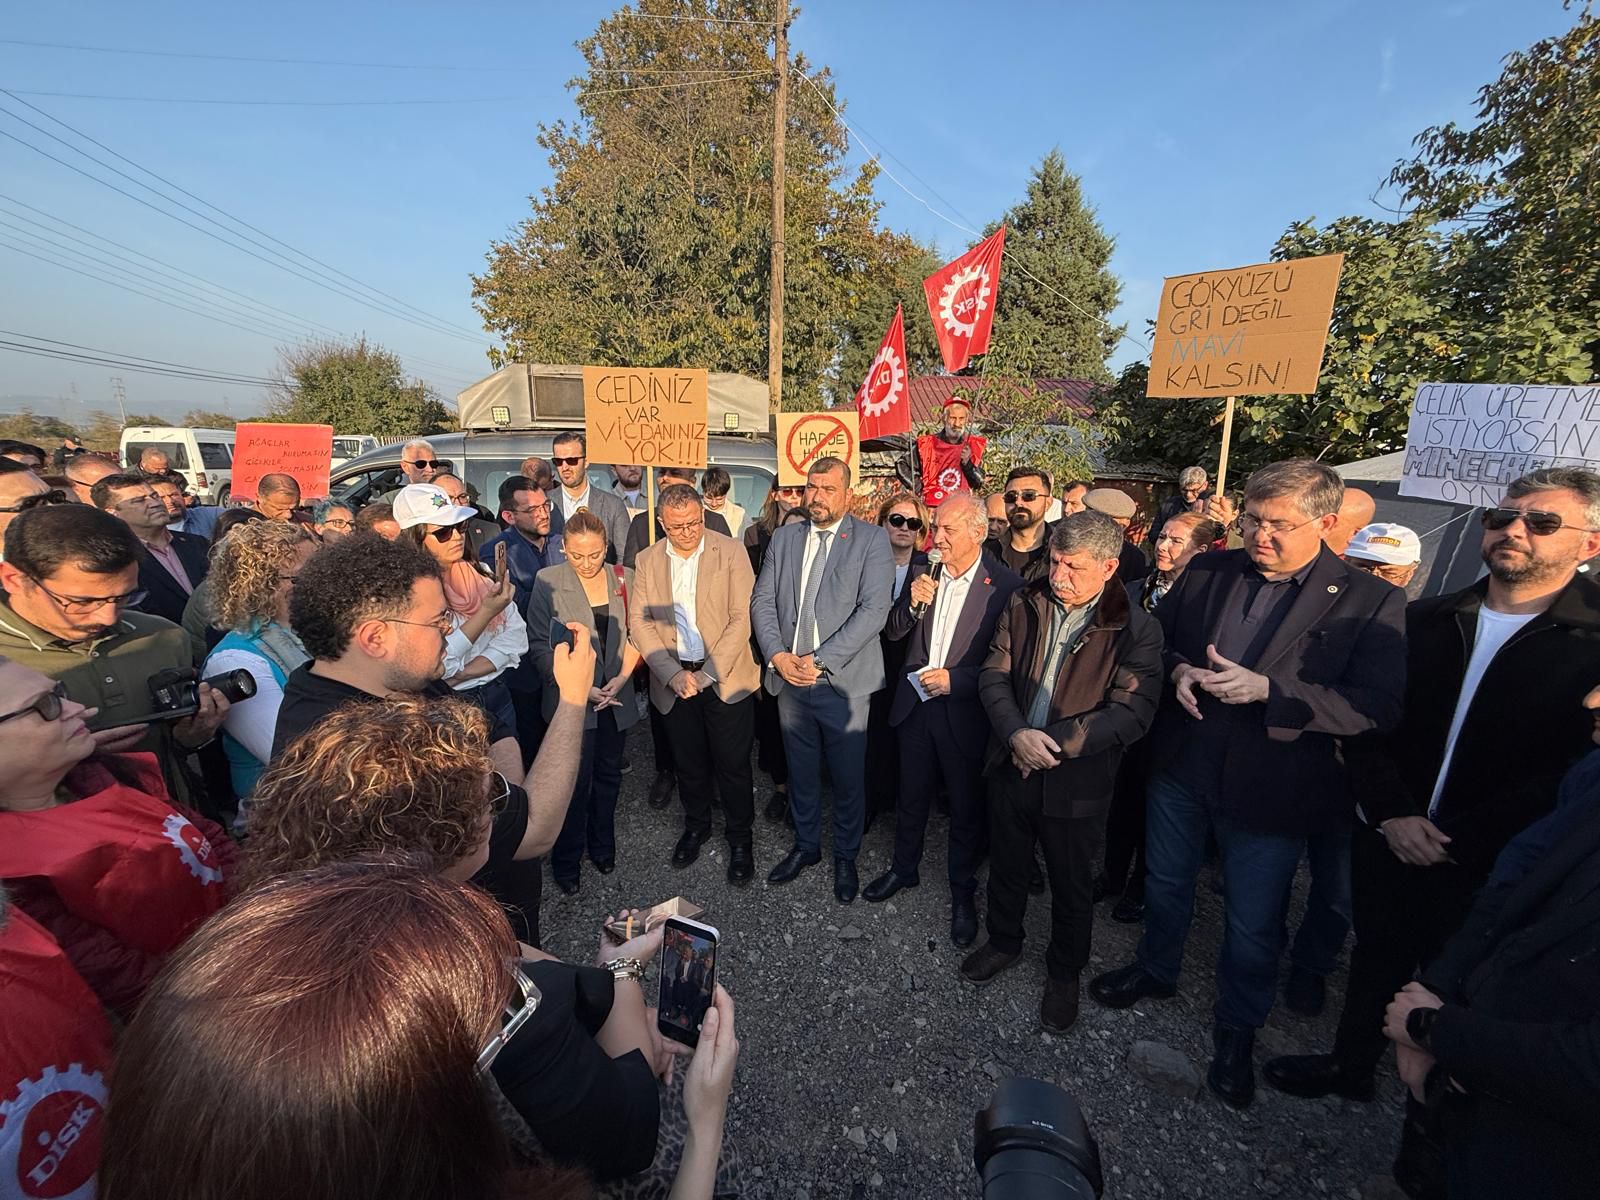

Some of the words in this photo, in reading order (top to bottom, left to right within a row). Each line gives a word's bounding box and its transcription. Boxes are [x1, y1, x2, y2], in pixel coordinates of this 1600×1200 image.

[1171, 266, 1294, 309] GÖKYÜZÜ
[1169, 305, 1212, 335] GRİ
[1222, 297, 1292, 327] DEĞİL
[1170, 328, 1247, 365] MAVİ
[595, 371, 693, 407] ÇEDİNİZ
[1166, 357, 1291, 390] KALSIN!
[625, 405, 661, 423] VAR
[1415, 384, 1474, 416] ÇELİK
[624, 440, 700, 466] YOK!!!
